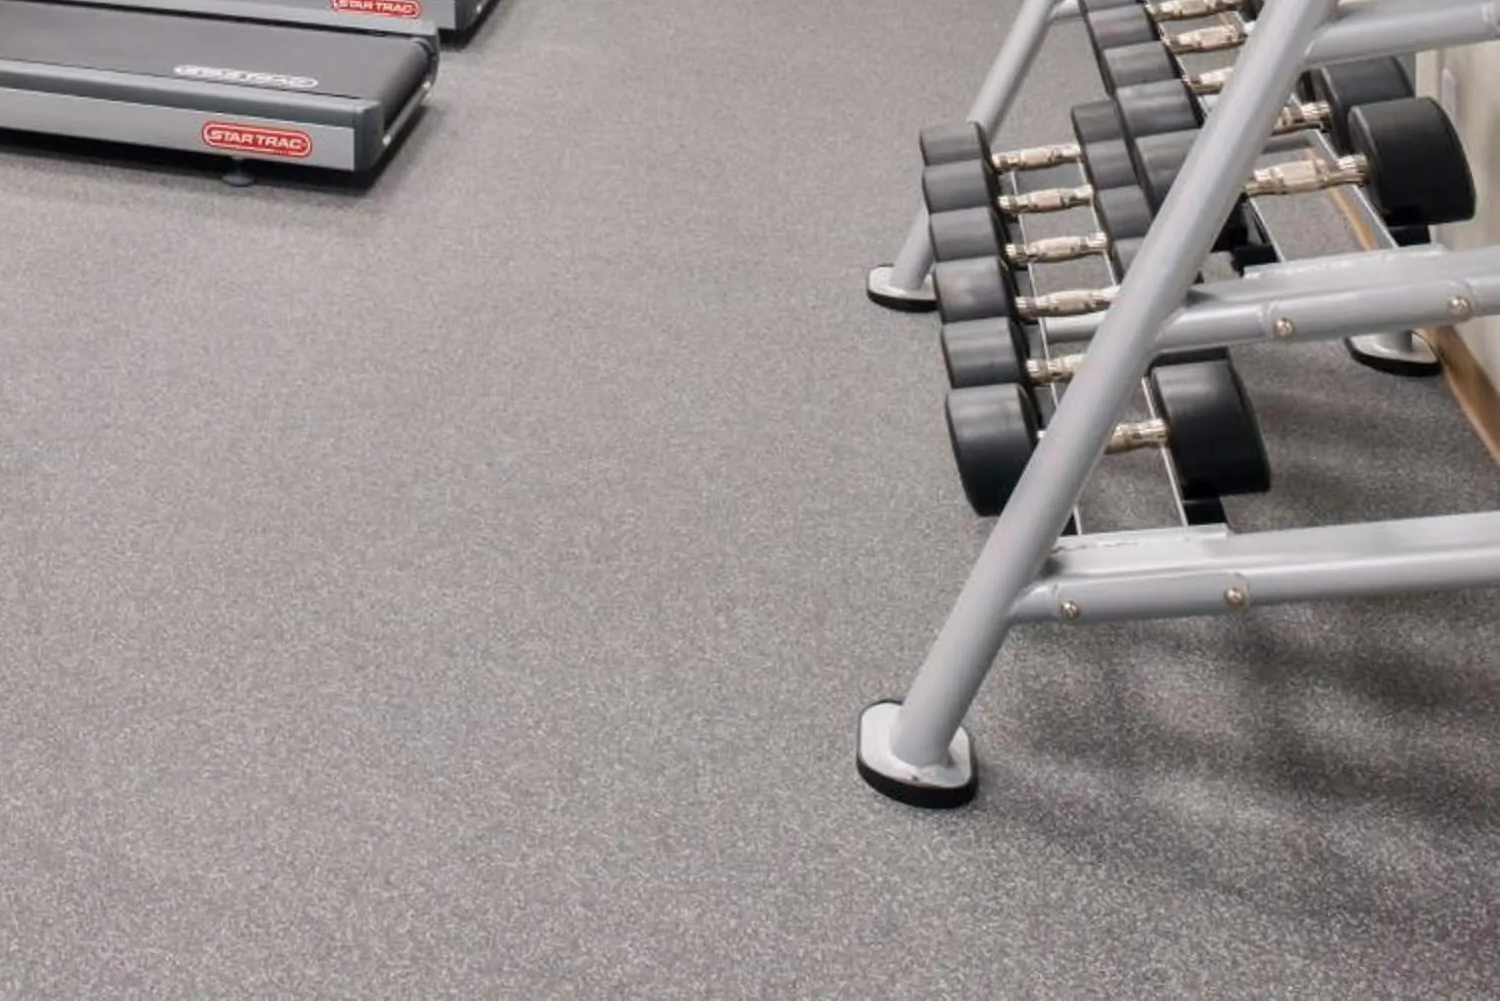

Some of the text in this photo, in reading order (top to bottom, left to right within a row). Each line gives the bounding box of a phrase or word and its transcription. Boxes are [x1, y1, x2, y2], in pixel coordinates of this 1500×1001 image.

[375, 2, 412, 13] TRAC
[210, 130, 303, 149] STAR TRAC
